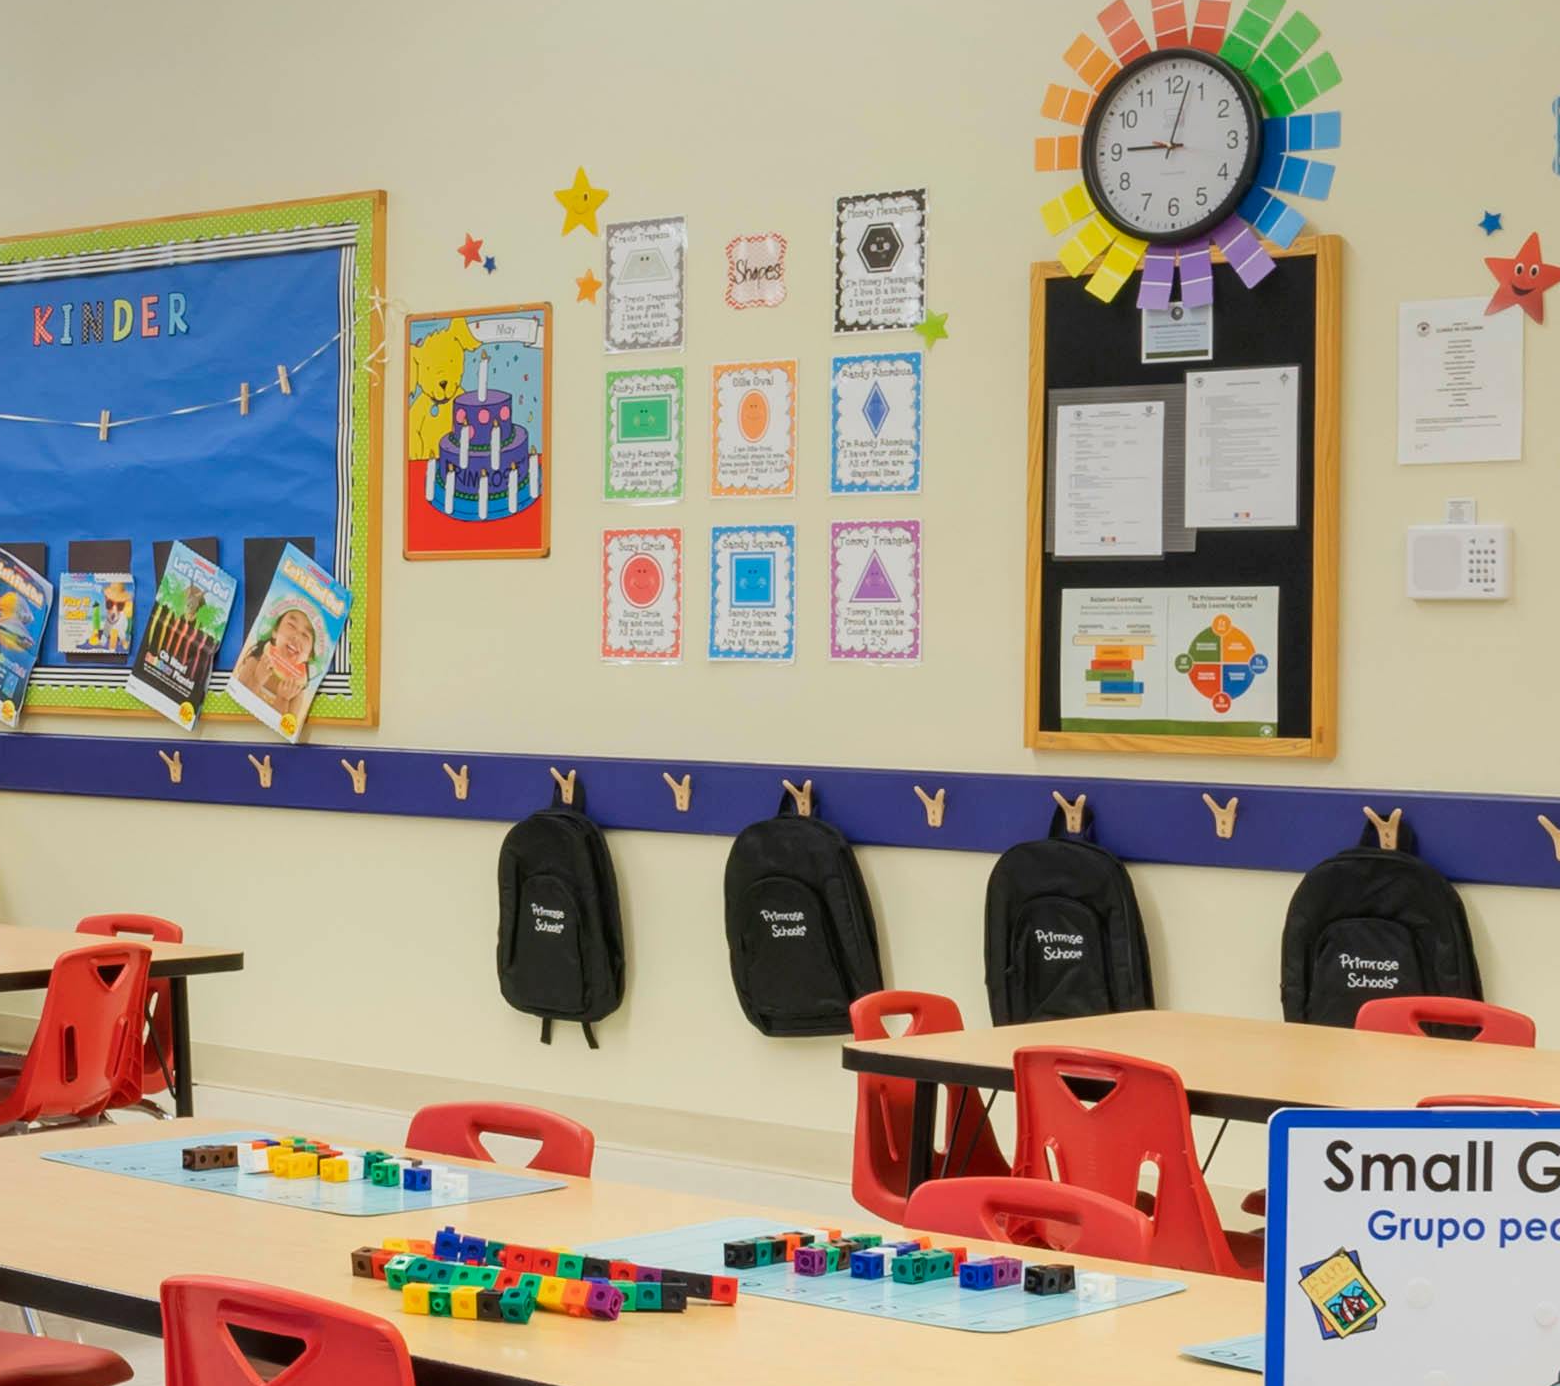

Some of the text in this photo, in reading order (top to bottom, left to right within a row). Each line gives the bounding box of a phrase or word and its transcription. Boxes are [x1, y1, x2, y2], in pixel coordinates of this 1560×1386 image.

[1165, 75, 1184, 94] 12
[1198, 83, 1204, 101] 1
[1138, 90, 1153, 107] 11
[1218, 100, 1229, 118] 2
[1120, 110, 1138, 129] 10
[1227, 131, 1239, 149] 3
[1112, 144, 1122, 161] 9
[1218, 163, 1228, 180] 4
[1119, 172, 1130, 190] 8
[1141, 193, 1152, 211] 7
[1196, 188, 1207, 205] 5
[1168, 198, 1180, 216] 6
[733, 259, 782, 290] Shapes
[32, 291, 190, 347] KINDER
[496, 324, 517, 337] May
[641, 542, 665, 550] Circle
[760, 909, 804, 922] Primrose
[1339, 953, 1400, 972] Primrose
[1323, 1139, 1494, 1193] Small
[1367, 1209, 1486, 1248] Grupo
